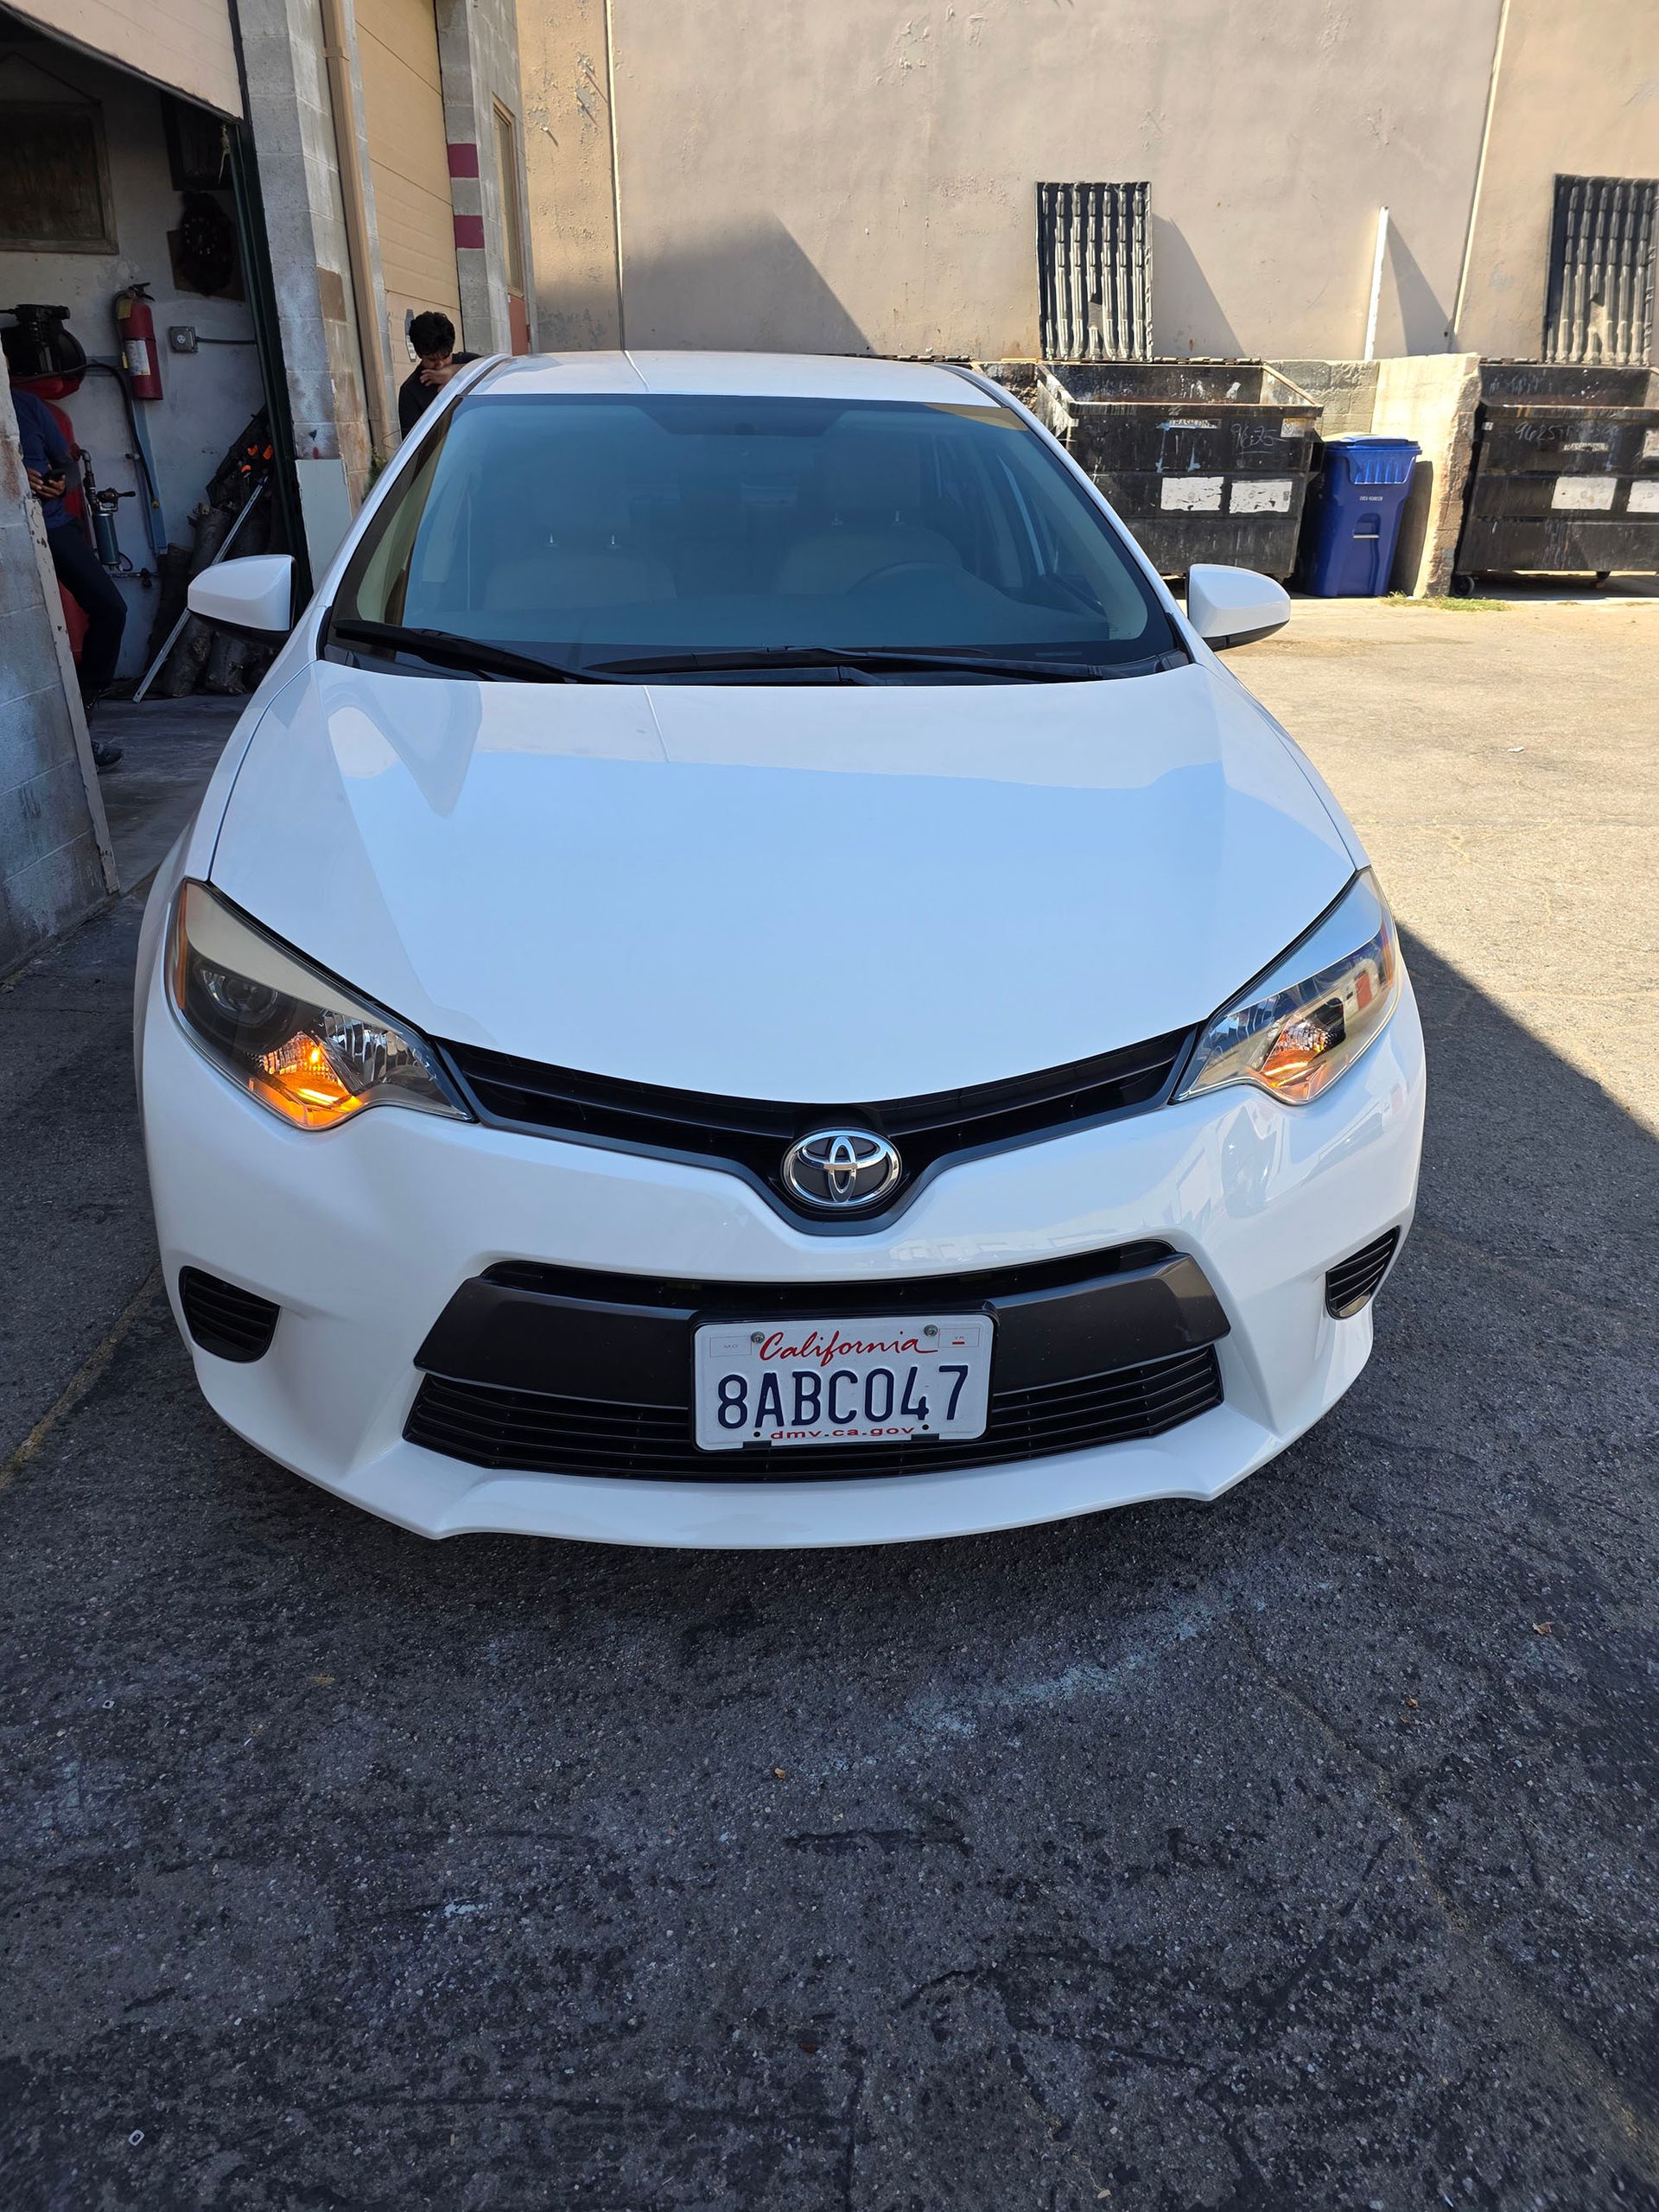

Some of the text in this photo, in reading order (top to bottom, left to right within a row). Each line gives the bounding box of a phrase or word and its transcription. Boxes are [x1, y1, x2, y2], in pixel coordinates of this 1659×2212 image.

[760, 1330, 938, 1367] California
[718, 1364, 969, 1429] 8ABC047
[770, 1427, 915, 1440] dmv.ca.gov
